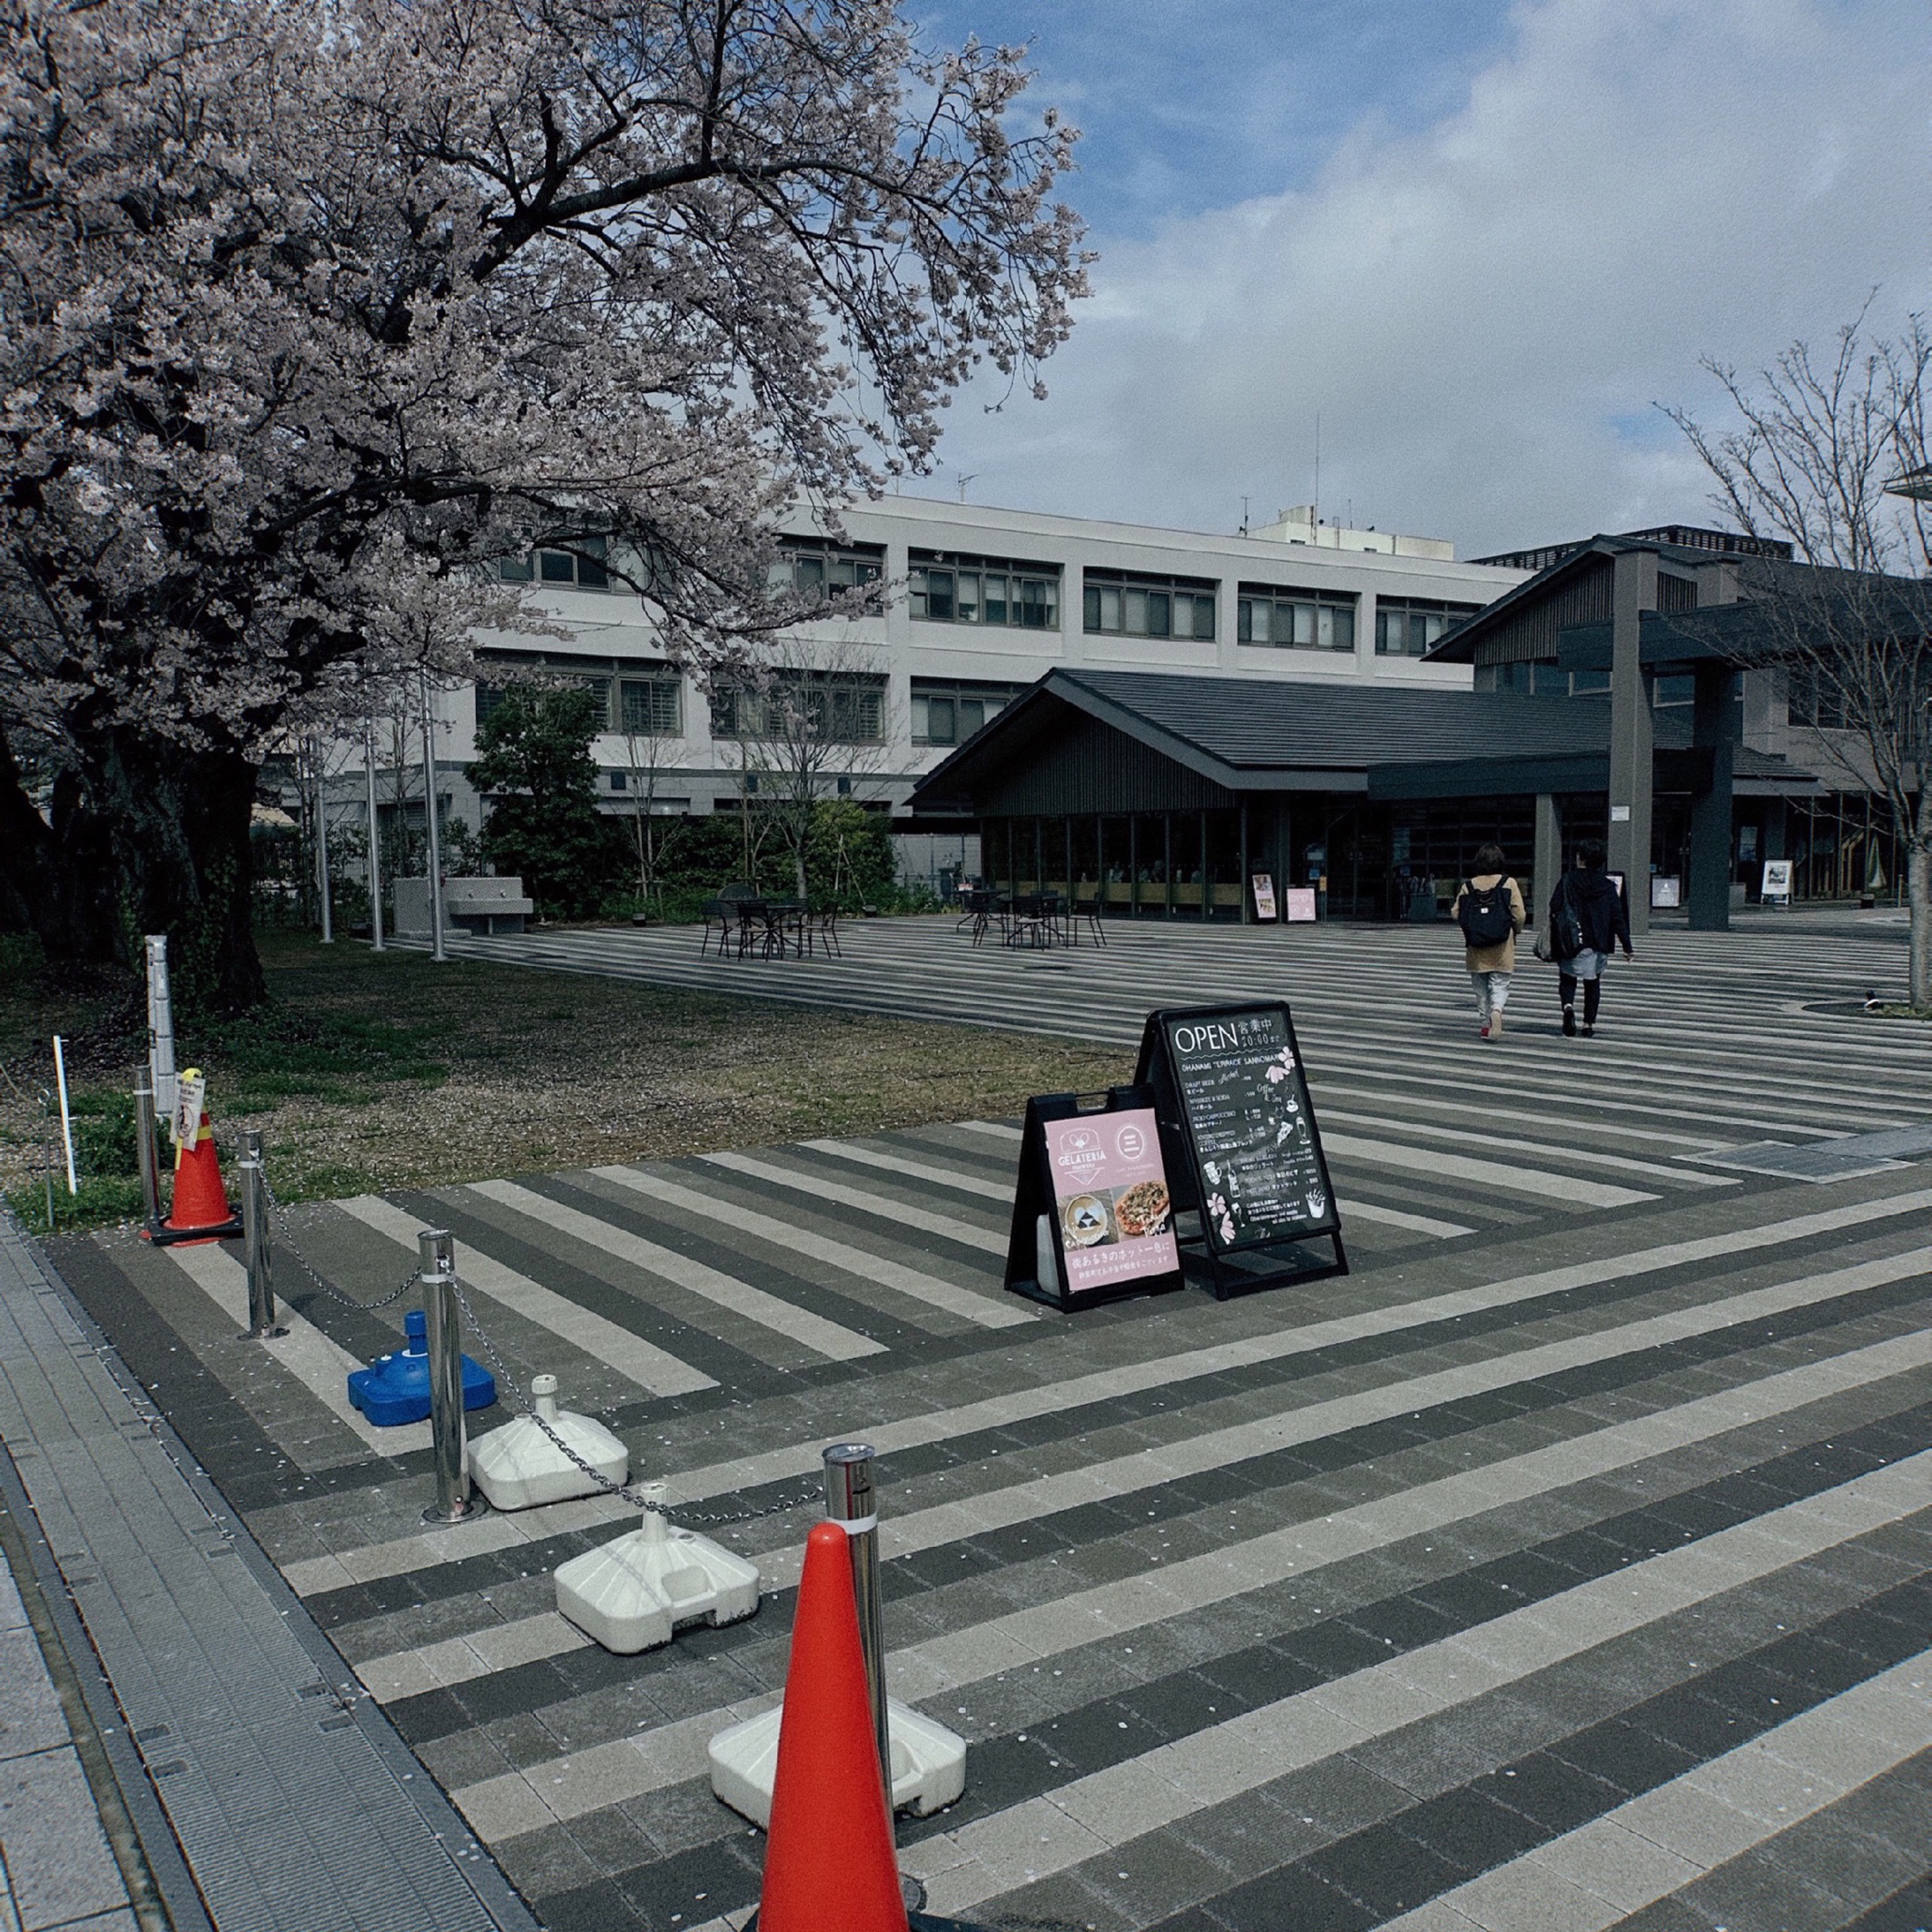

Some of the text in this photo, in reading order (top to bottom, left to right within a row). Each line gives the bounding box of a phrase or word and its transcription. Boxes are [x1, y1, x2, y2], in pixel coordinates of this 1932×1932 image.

[1237, 1018, 1272, 1034] 営業中
[1175, 1022, 1238, 1052] OPEN
[1058, 1150, 1107, 1166] GELATERIA
